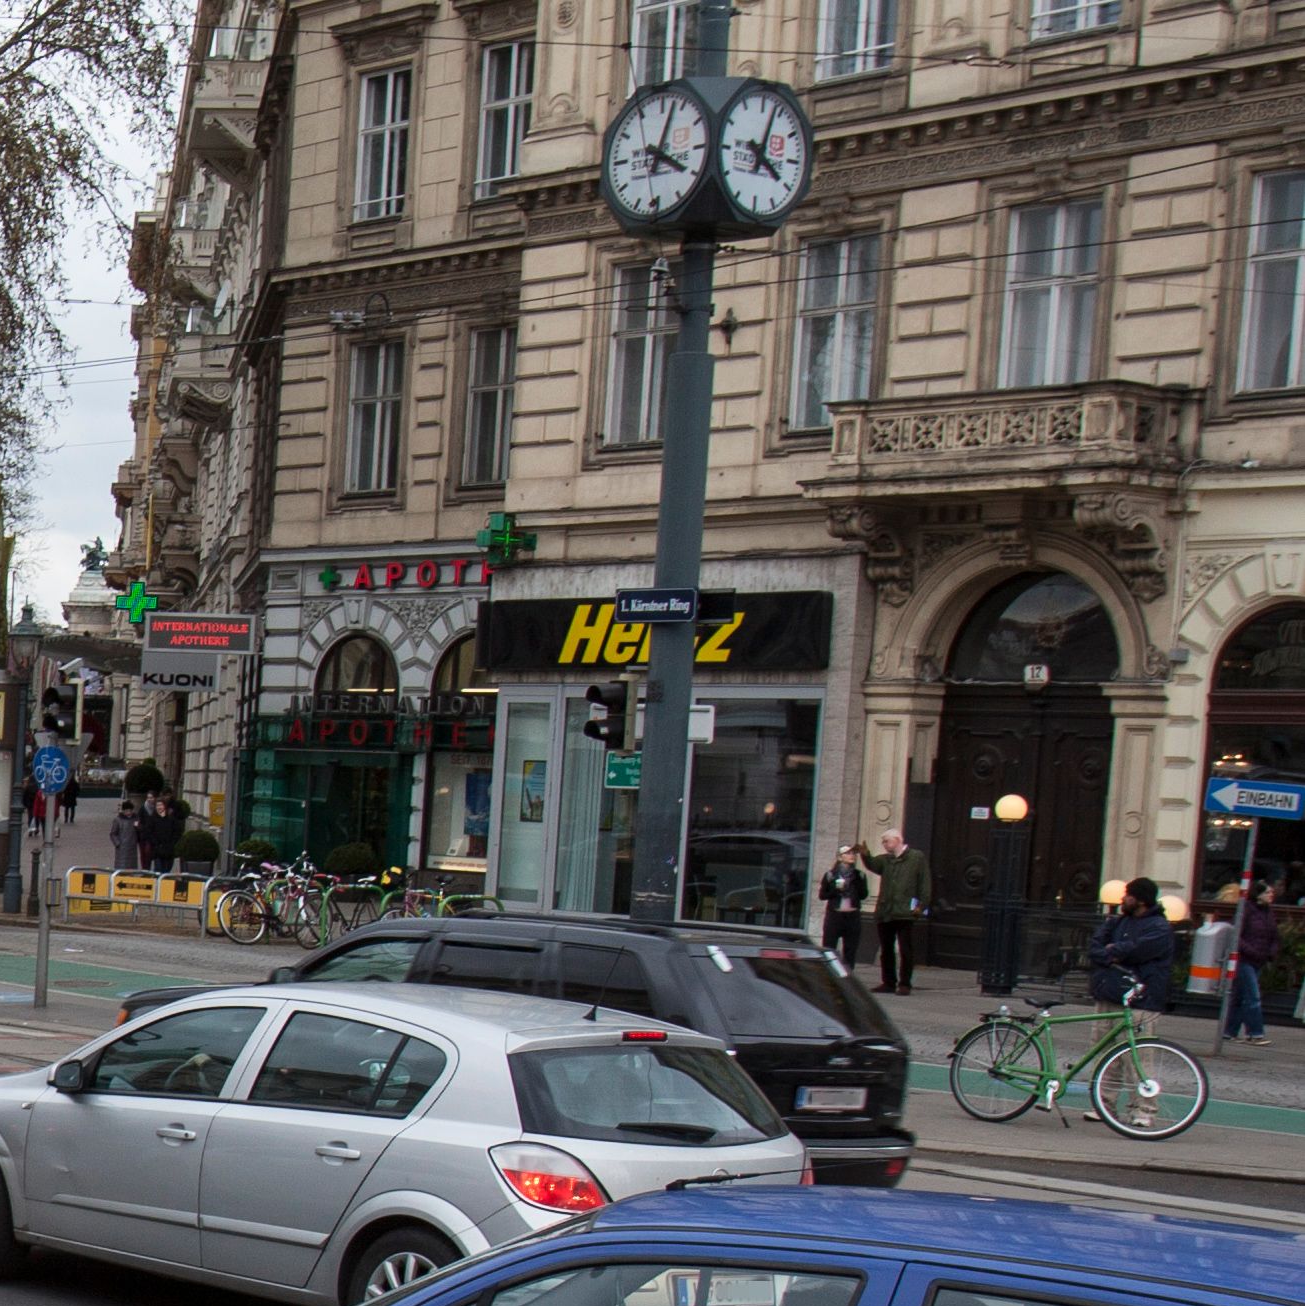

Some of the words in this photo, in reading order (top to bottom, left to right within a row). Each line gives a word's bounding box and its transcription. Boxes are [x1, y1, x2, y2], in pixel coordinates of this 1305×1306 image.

[631, 599, 668, 611] Kärntner
[670, 598, 690, 613] Ring
[152, 620, 249, 634] INTERNATIONALE
[558, 603, 745, 663] Hez
[170, 635, 230, 647] APOTHEKE
[143, 673, 213, 687] KUONI
[290, 694, 489, 713] INTERNATION
[1237, 789, 1294, 808] EINBAHN
